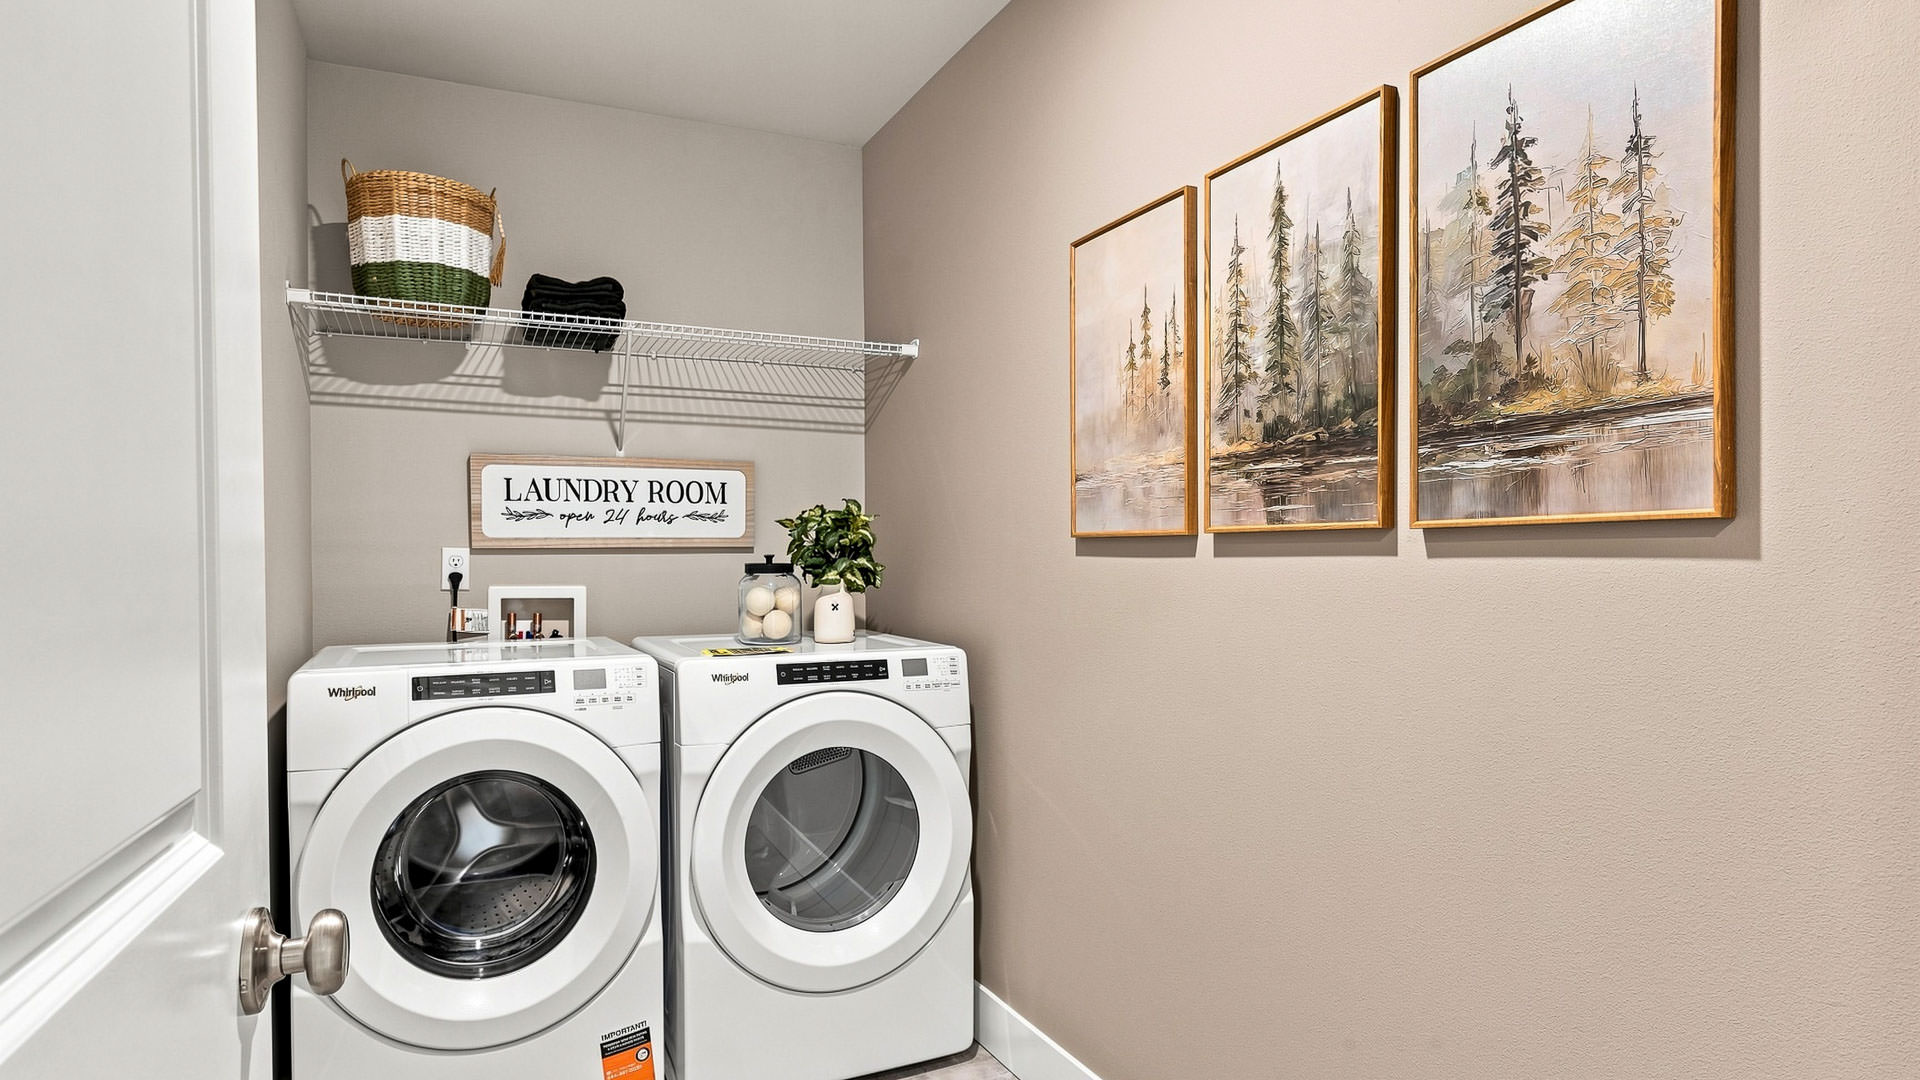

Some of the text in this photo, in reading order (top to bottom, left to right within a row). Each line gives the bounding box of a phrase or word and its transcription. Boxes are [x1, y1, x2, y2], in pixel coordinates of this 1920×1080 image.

[503, 477, 728, 505] LAUNDRY ROOM
[559, 507, 679, 528] open 24 hours
[711, 672, 749, 685] Whirlpool
[327, 686, 376, 701] Whirlpool
